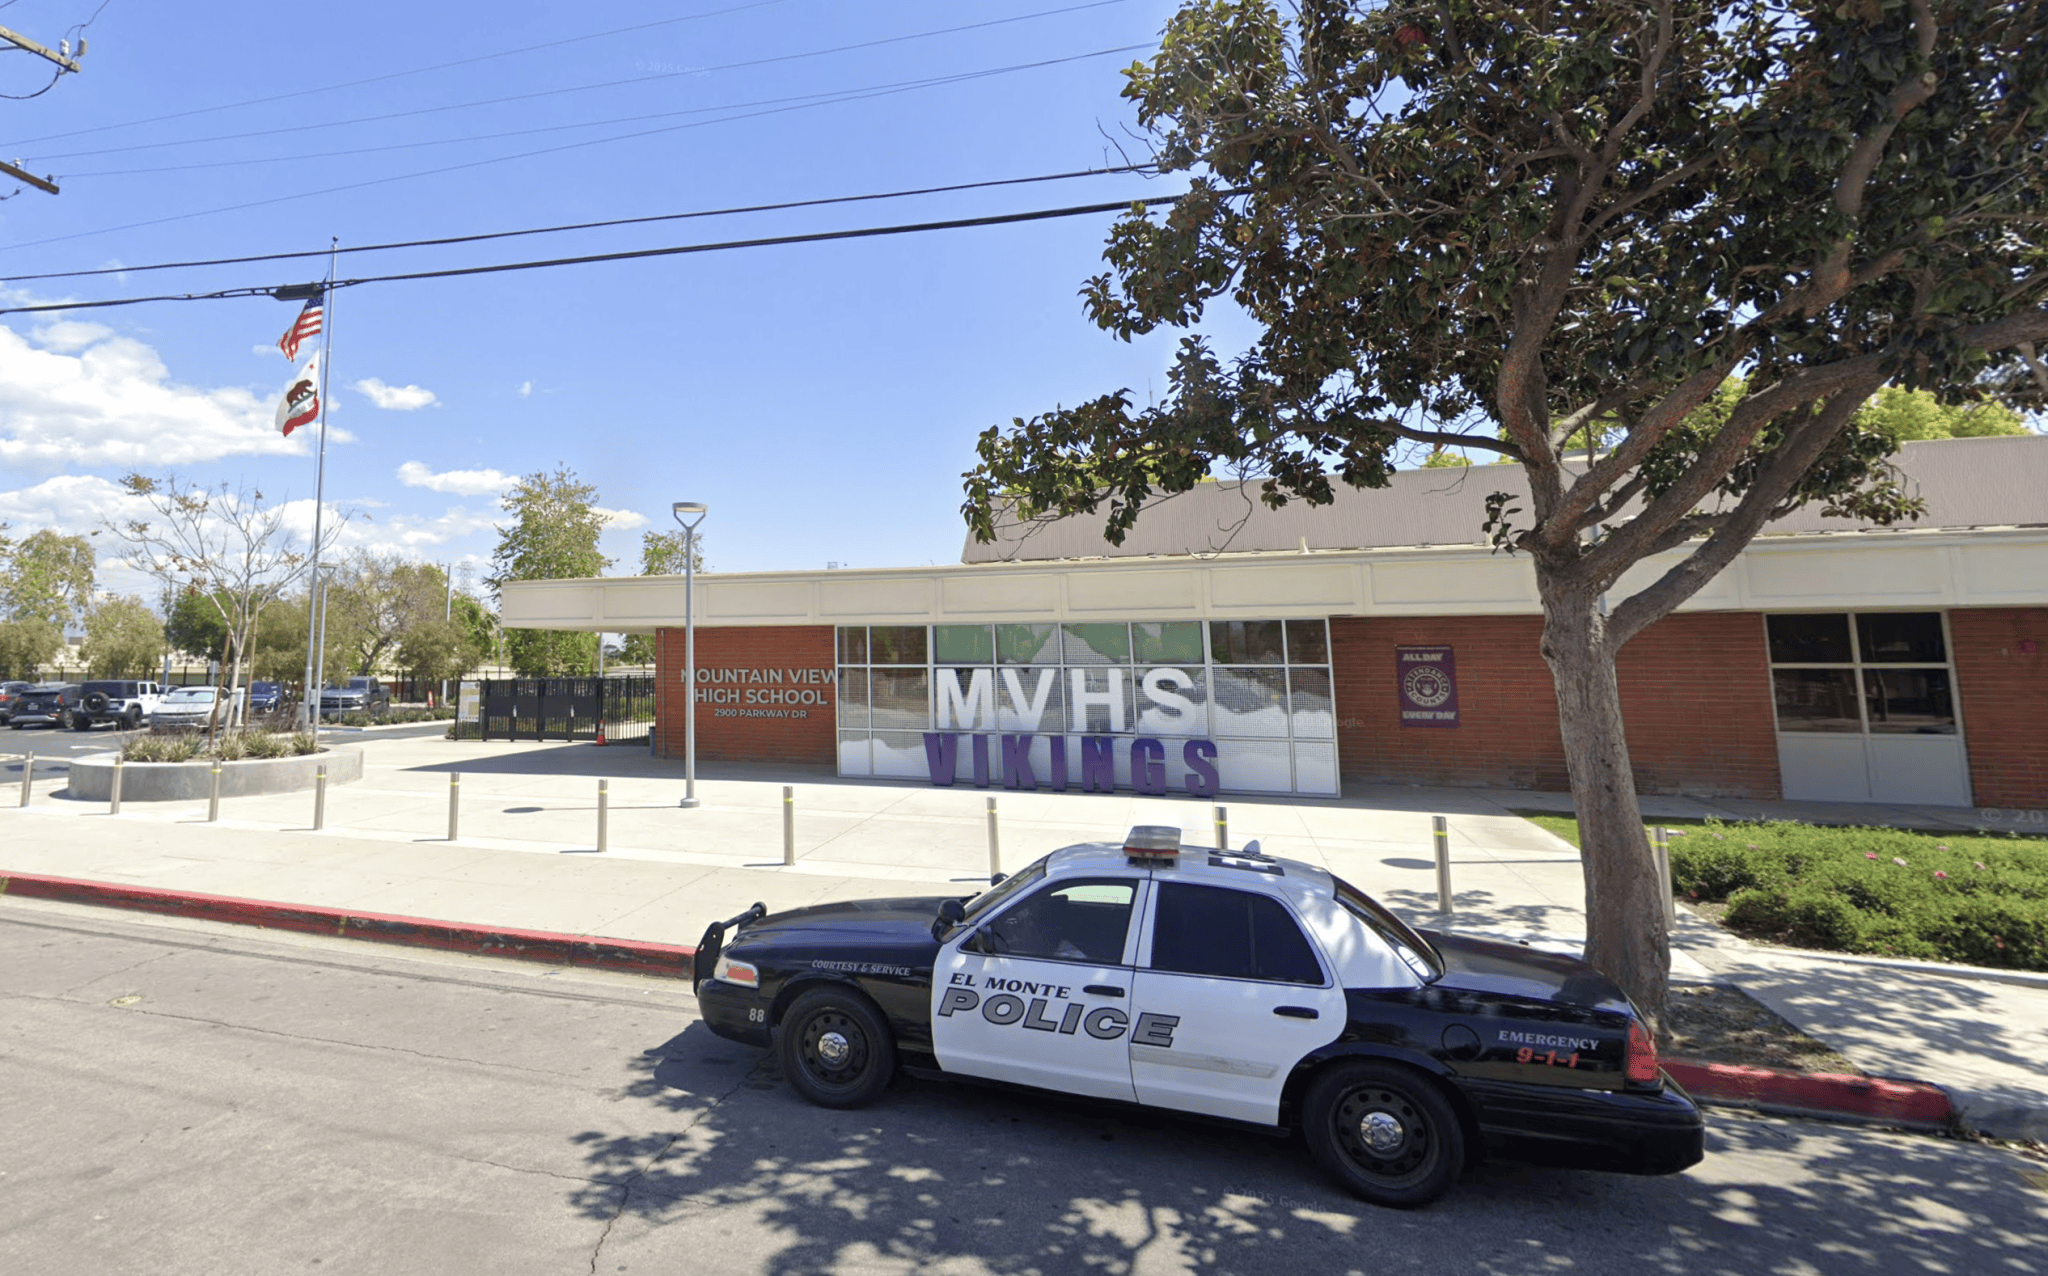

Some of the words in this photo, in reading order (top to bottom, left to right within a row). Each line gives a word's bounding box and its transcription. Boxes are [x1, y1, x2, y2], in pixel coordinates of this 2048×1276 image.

[1402, 653, 1421, 661] ALL
[1422, 653, 1443, 661] DAY
[788, 668, 836, 684] VIEW
[1406, 668, 1447, 686] ATTENDANCE
[694, 688, 741, 703] HIGH
[746, 689, 827, 705] SCHOOL
[936, 667, 1197, 733] MVHS
[1411, 692, 1445, 704] COUNTS
[714, 708, 737, 717] 2900
[739, 709, 790, 718] PARKWAY
[792, 710, 807, 719] DR
[1402, 711, 1434, 719] EVERY
[1435, 711, 1457, 720] DAY
[923, 732, 1220, 797] VIKINGS
[811, 960, 860, 971] COURTESY
[860, 963, 868, 972] &
[870, 964, 911, 976] SERVICE
[950, 972, 977, 987] EL
[985, 976, 1071, 999] MONTE
[749, 1008, 765, 1023] 88
[937, 986, 1180, 1048] POLICE
[1498, 1029, 1600, 1050] EMERGENCY
[1516, 1047, 1580, 1068] 9-1-1
